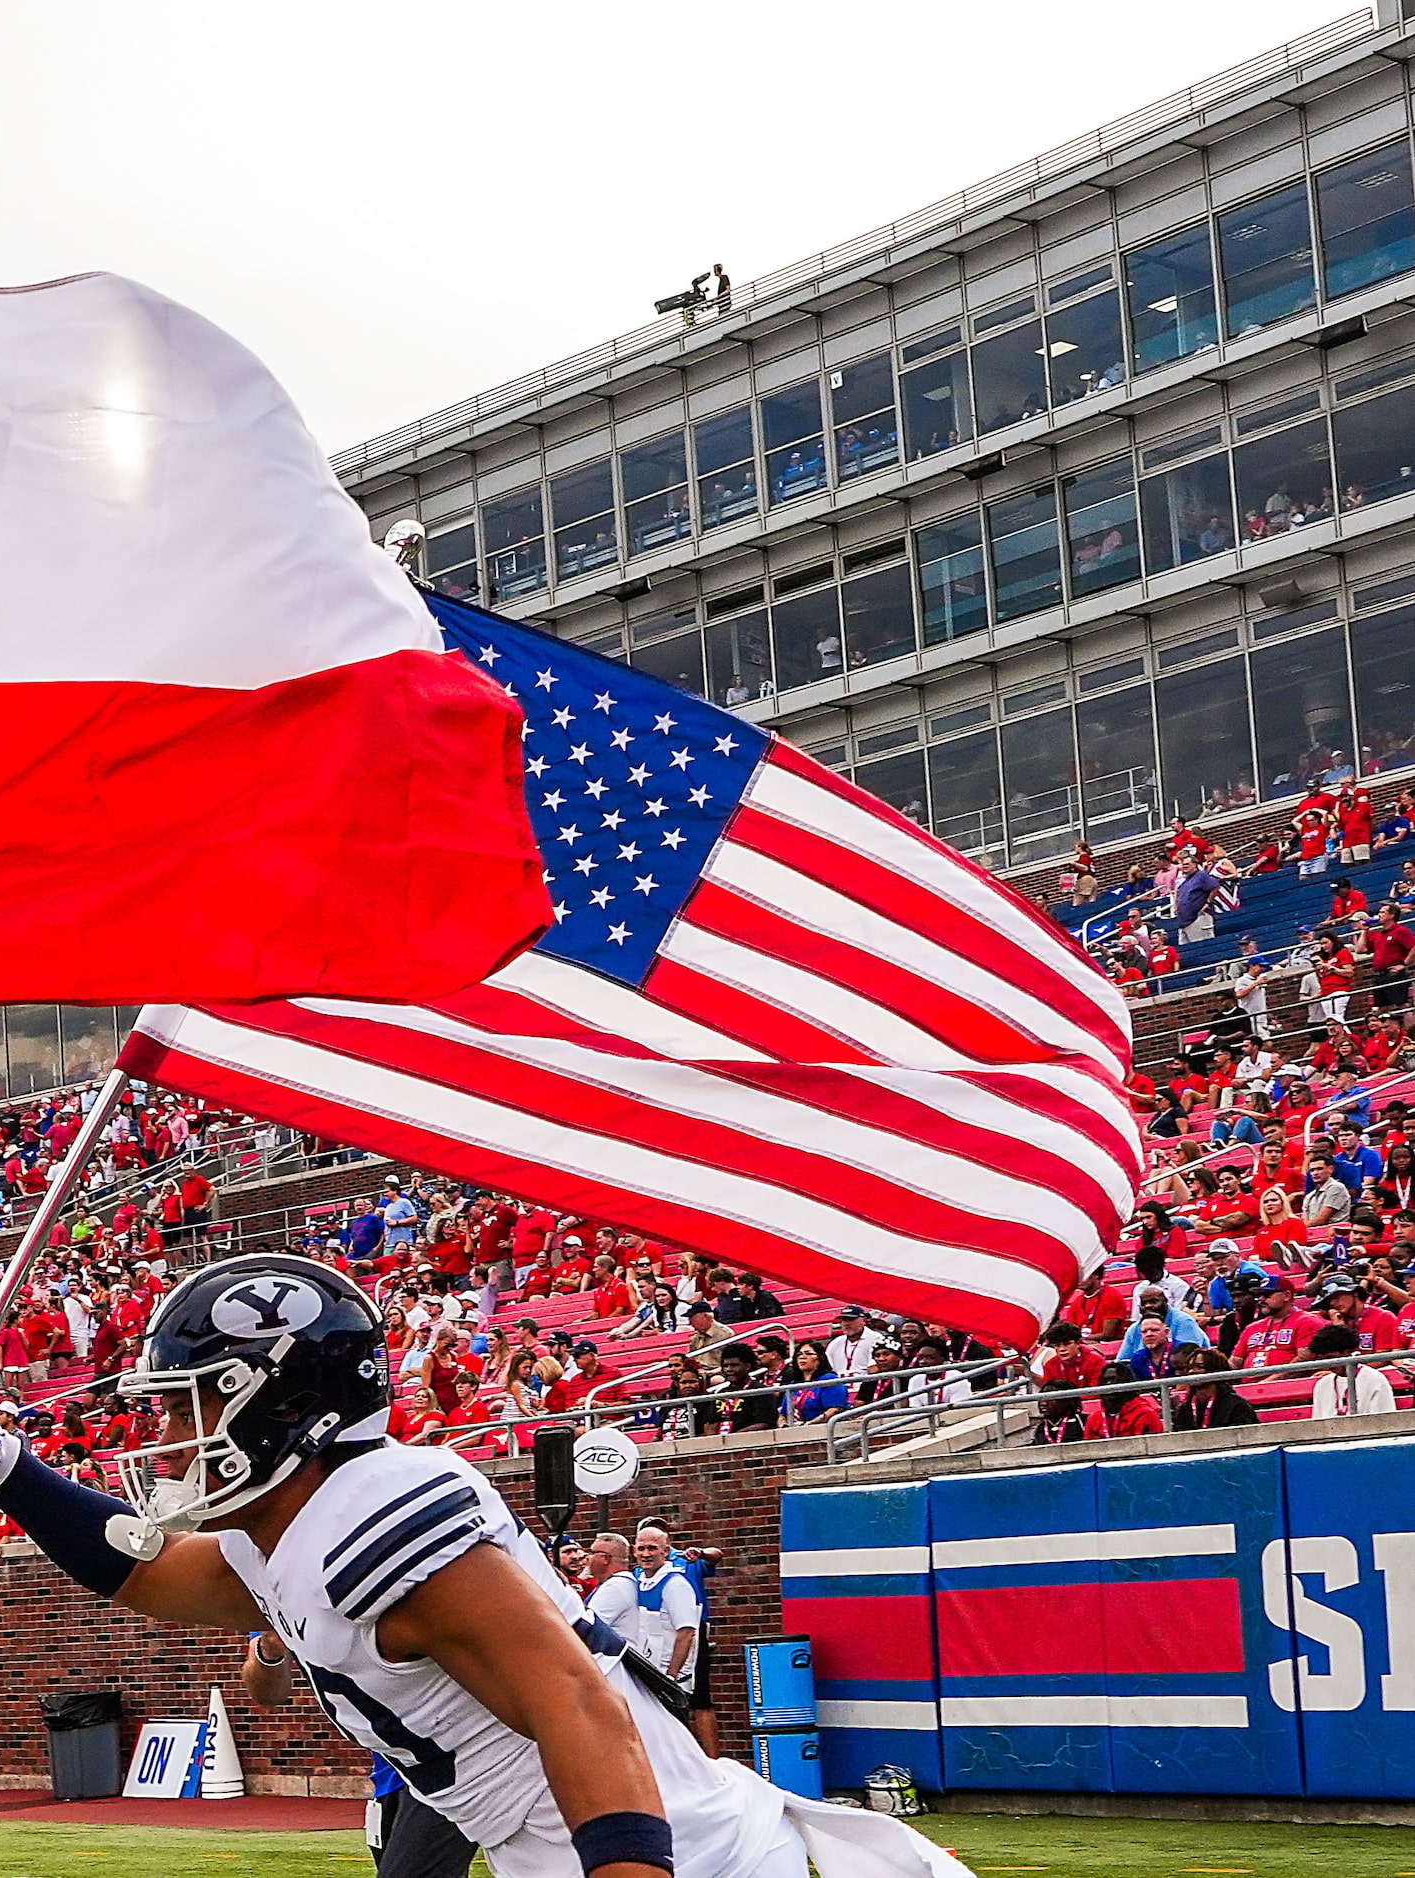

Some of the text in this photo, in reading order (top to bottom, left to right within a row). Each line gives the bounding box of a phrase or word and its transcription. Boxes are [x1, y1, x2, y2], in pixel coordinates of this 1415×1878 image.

[224, 1281, 300, 1330] Y
[376, 1368, 388, 1387] 30
[582, 1452, 619, 1463] ACC
[137, 1736, 176, 1784] ON
[203, 1713, 219, 1771] SMU
